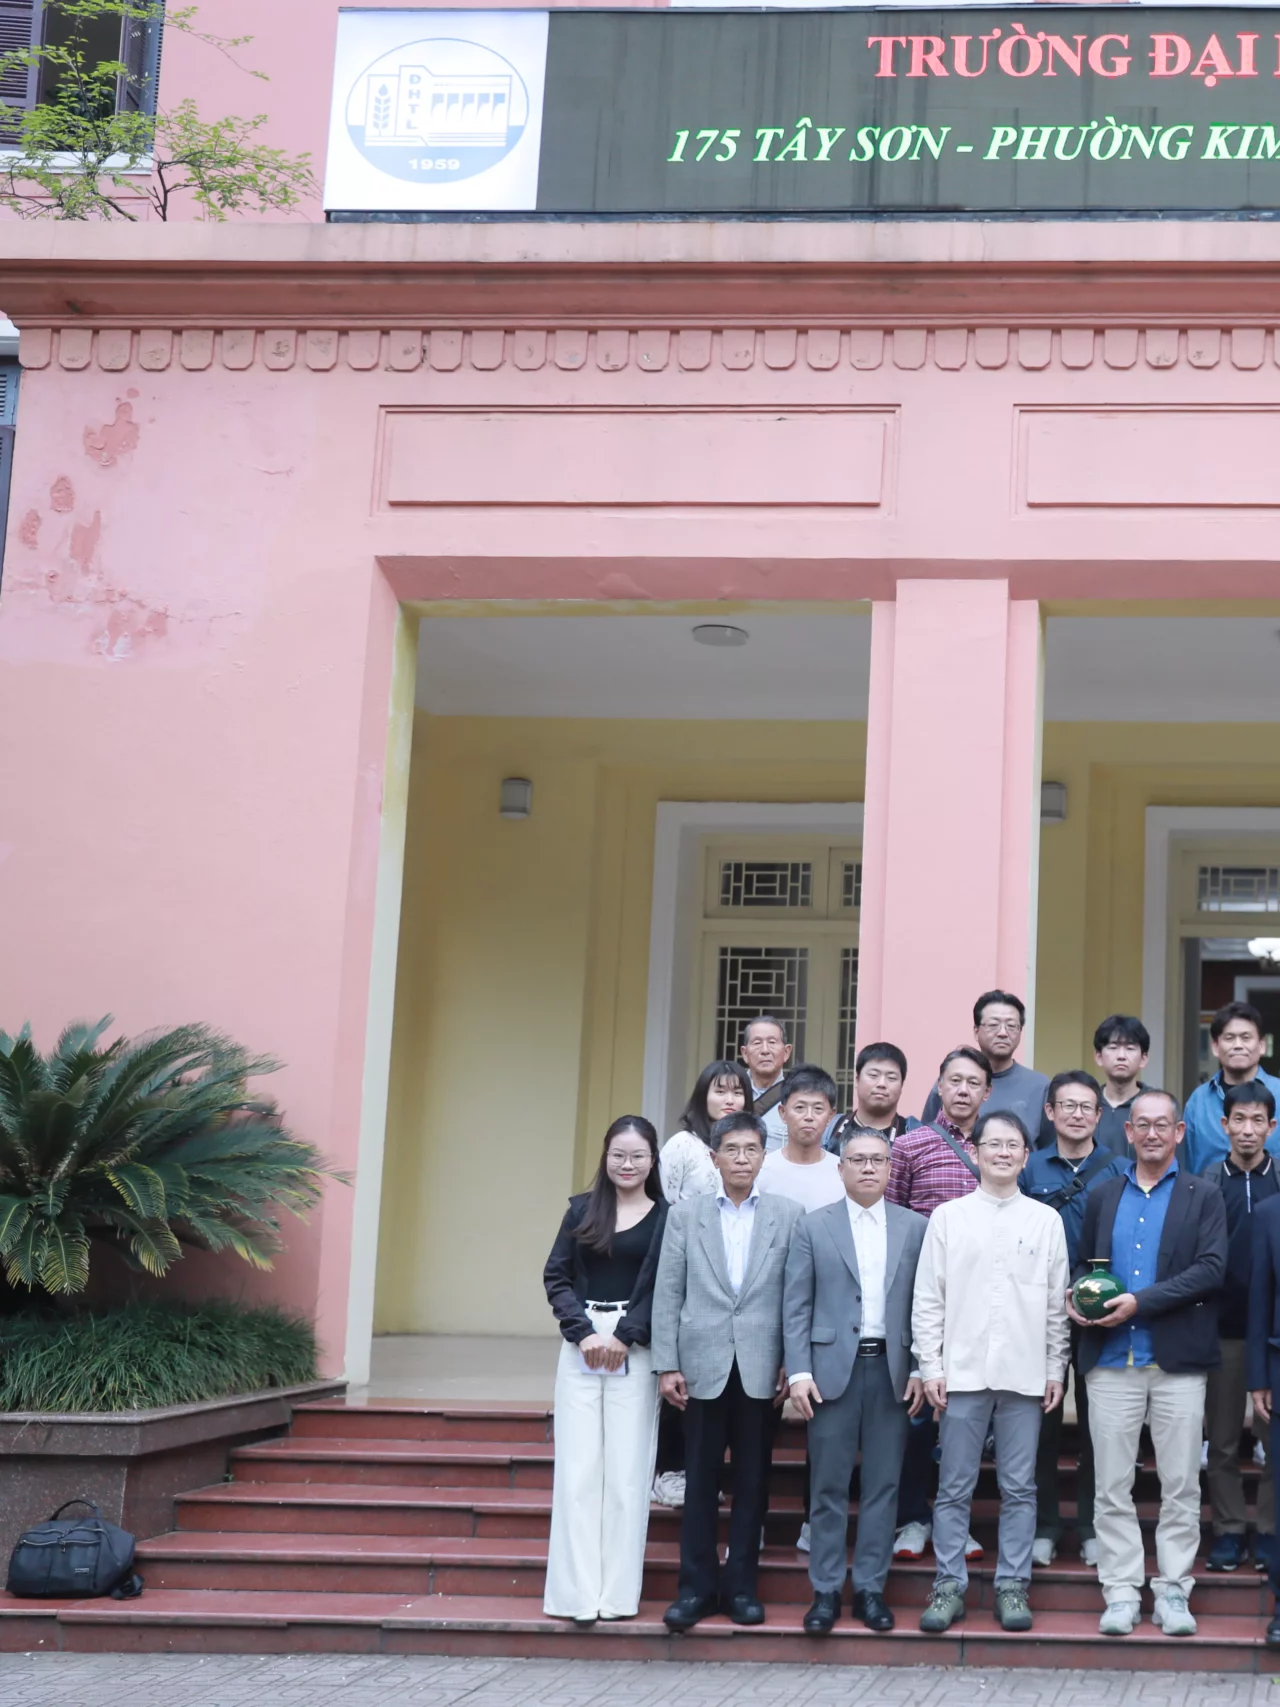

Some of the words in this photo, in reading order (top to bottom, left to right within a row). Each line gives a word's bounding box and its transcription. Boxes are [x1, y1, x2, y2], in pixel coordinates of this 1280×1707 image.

[867, 23, 1132, 78] TRƯỜNG
[1148, 33, 1260, 87] ĐẠI
[666, 127, 740, 162] 175
[752, 116, 845, 162] TÂY
[849, 124, 952, 162] SƠN
[955, 142, 975, 153] -
[982, 115, 1195, 162] PHƯỜNG
[408, 158, 460, 170] 1959
